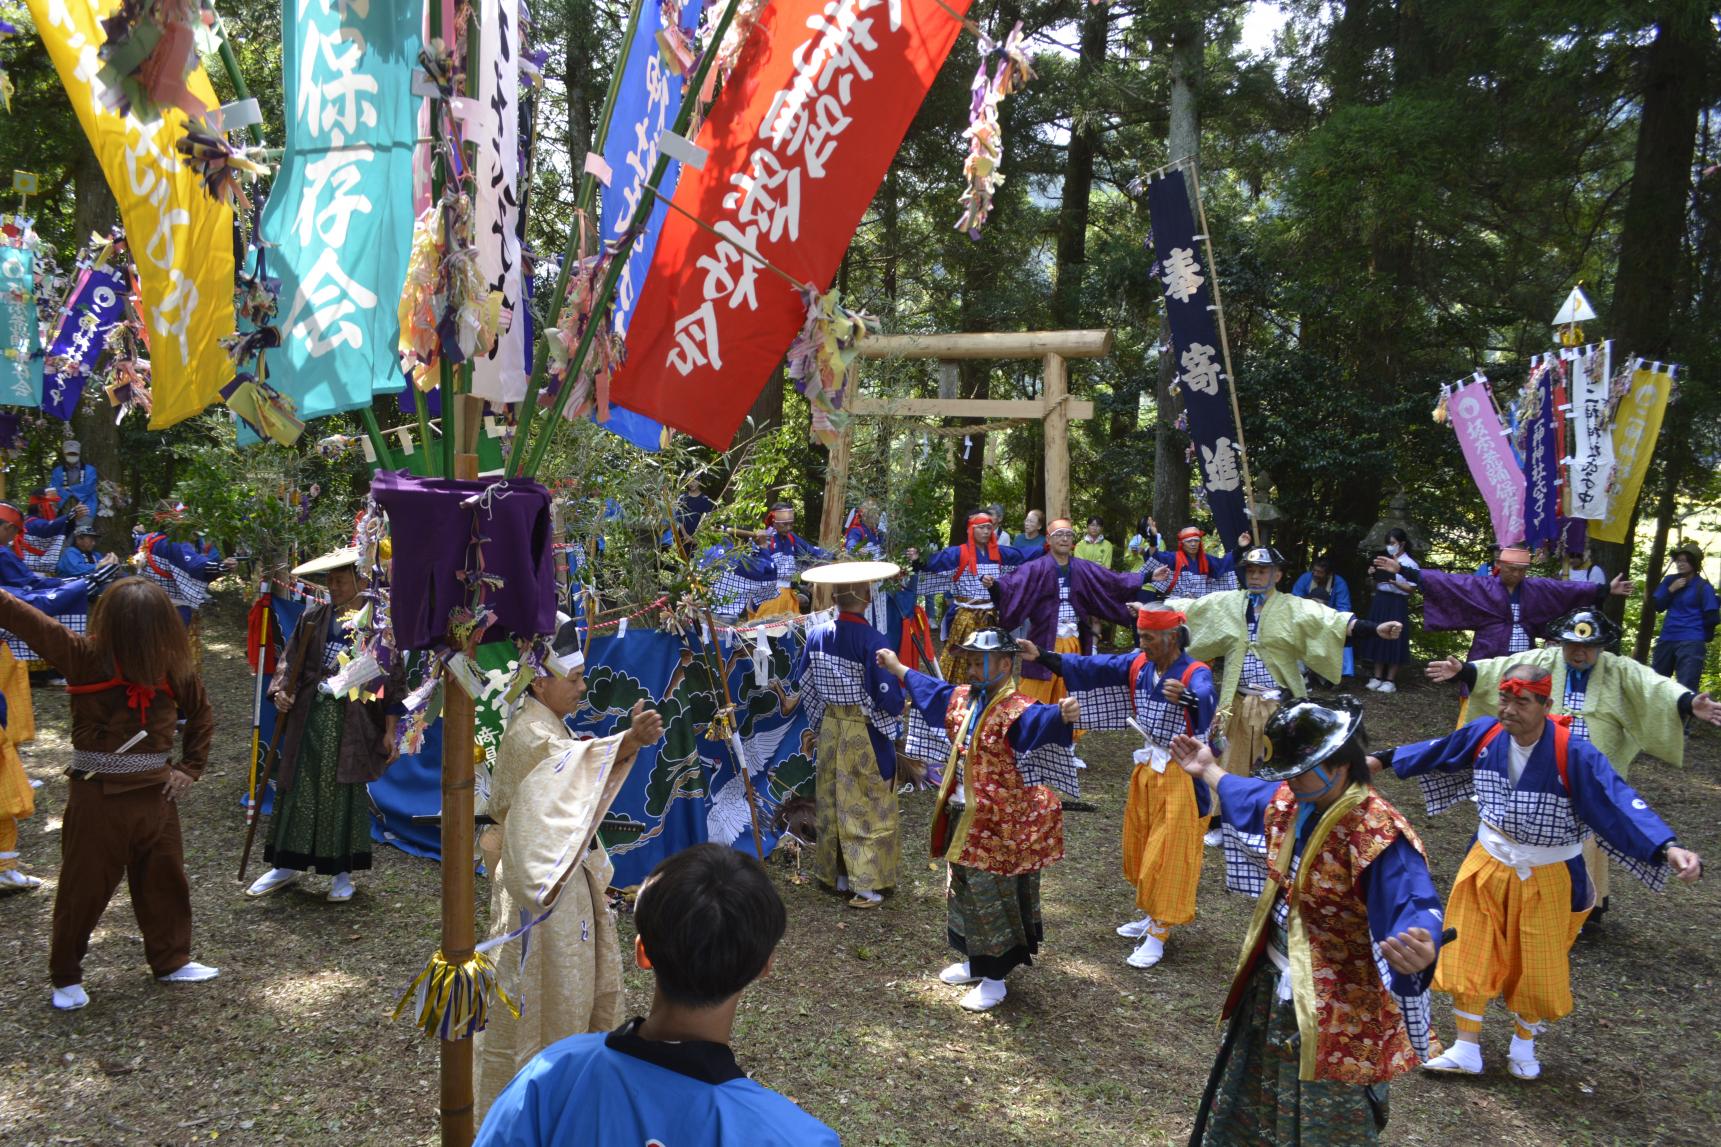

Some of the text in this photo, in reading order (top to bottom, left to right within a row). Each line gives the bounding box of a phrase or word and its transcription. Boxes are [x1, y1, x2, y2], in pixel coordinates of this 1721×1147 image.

[282, 0, 379, 358] 保存会
[1161, 247, 1241, 492] 奉寄進
